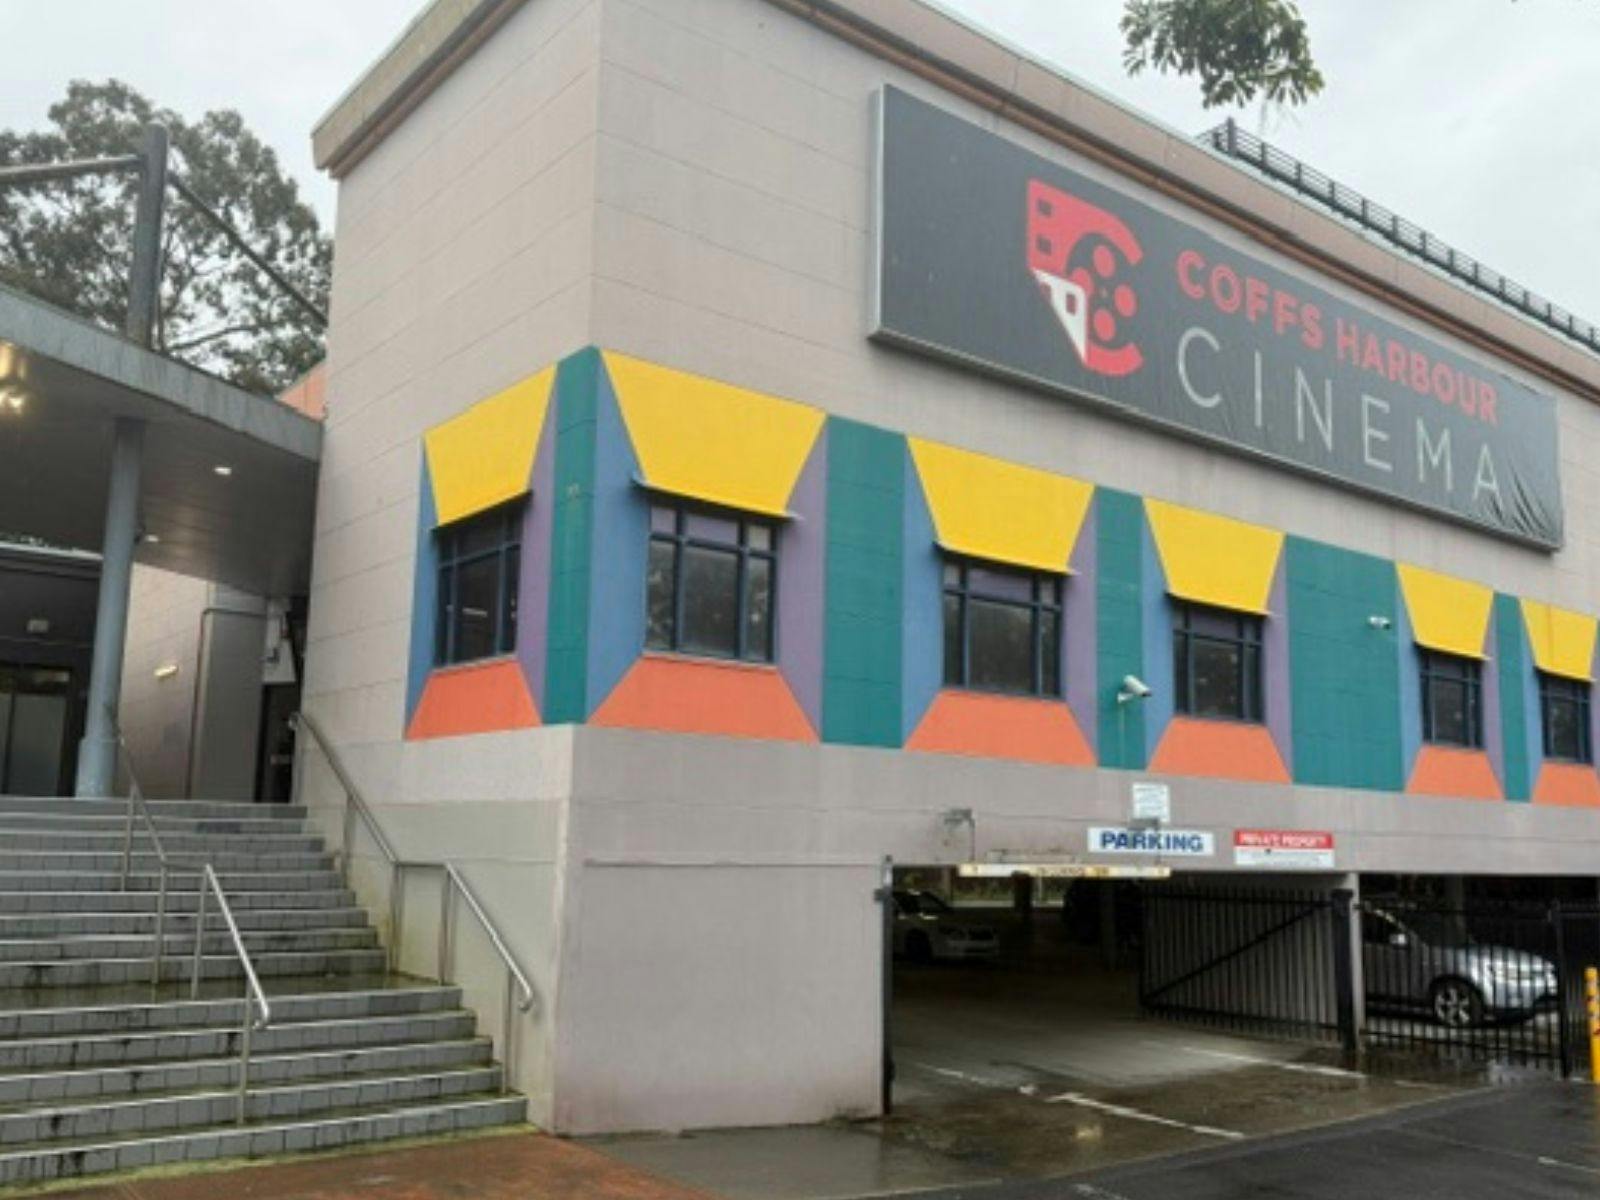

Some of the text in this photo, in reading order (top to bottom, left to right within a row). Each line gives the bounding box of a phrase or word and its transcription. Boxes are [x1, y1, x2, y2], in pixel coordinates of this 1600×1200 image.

[1177, 250, 1498, 428] COFFS HARBOUR
[1177, 326, 1503, 510] CINEMA
[1101, 830, 1203, 853] PARKING
